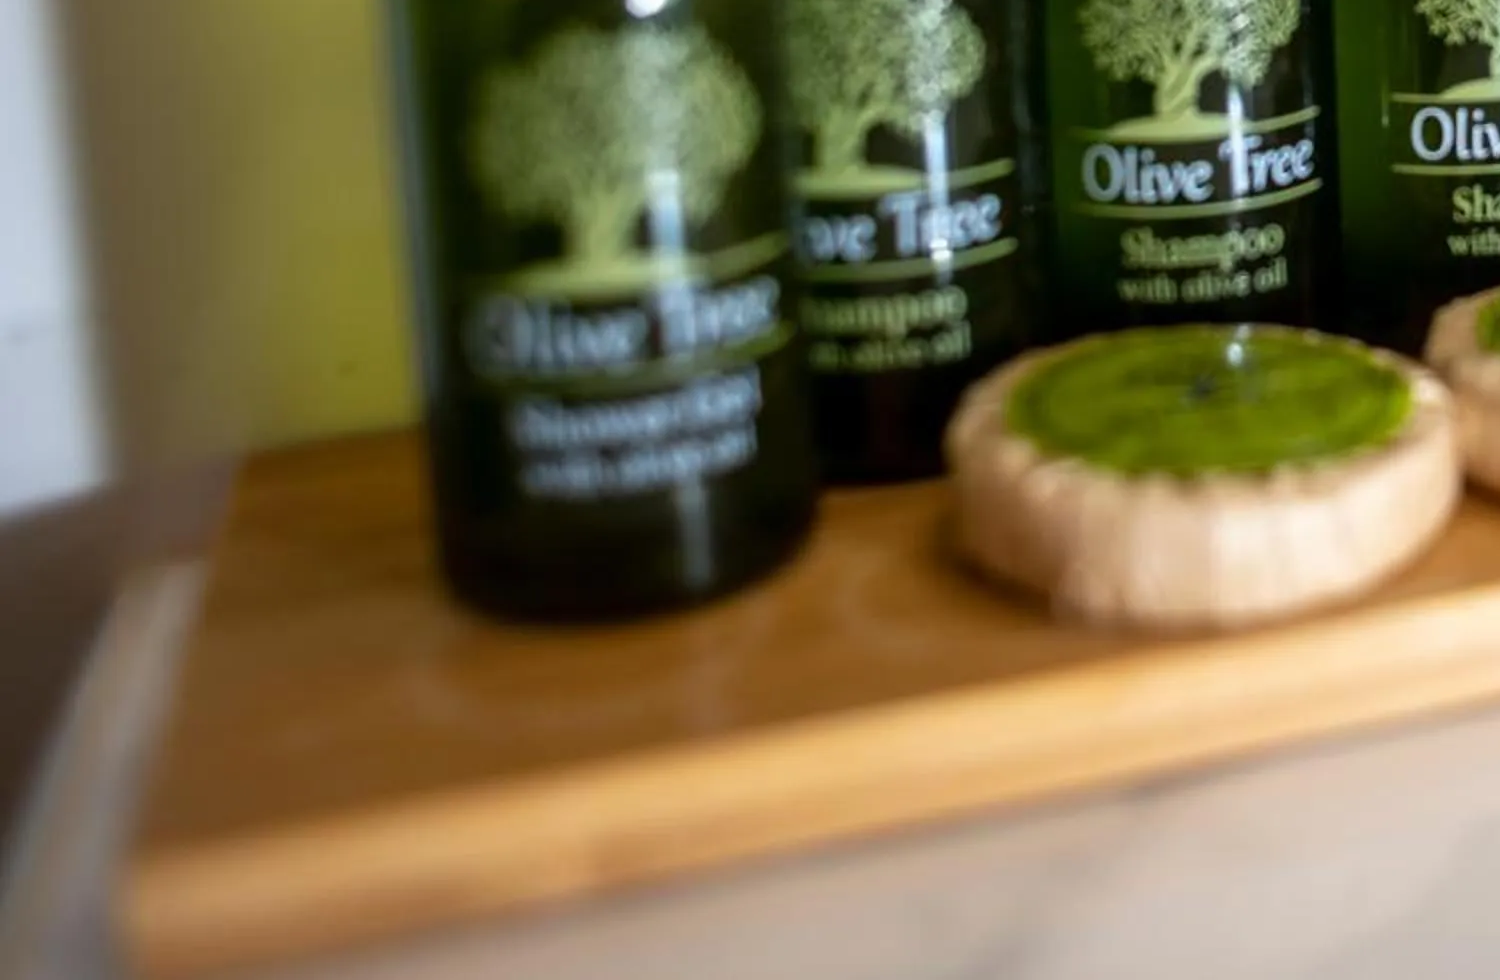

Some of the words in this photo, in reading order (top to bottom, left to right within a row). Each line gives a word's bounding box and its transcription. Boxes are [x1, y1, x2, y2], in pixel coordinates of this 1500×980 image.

[1082, 143, 1214, 204] Olive
[1218, 134, 1315, 196] Tree
[876, 192, 1002, 257] Tree
[1120, 222, 1285, 272] Shampoo
[1118, 272, 1178, 303] with
[1181, 270, 1250, 303] olive
[1253, 256, 1288, 293] oil
